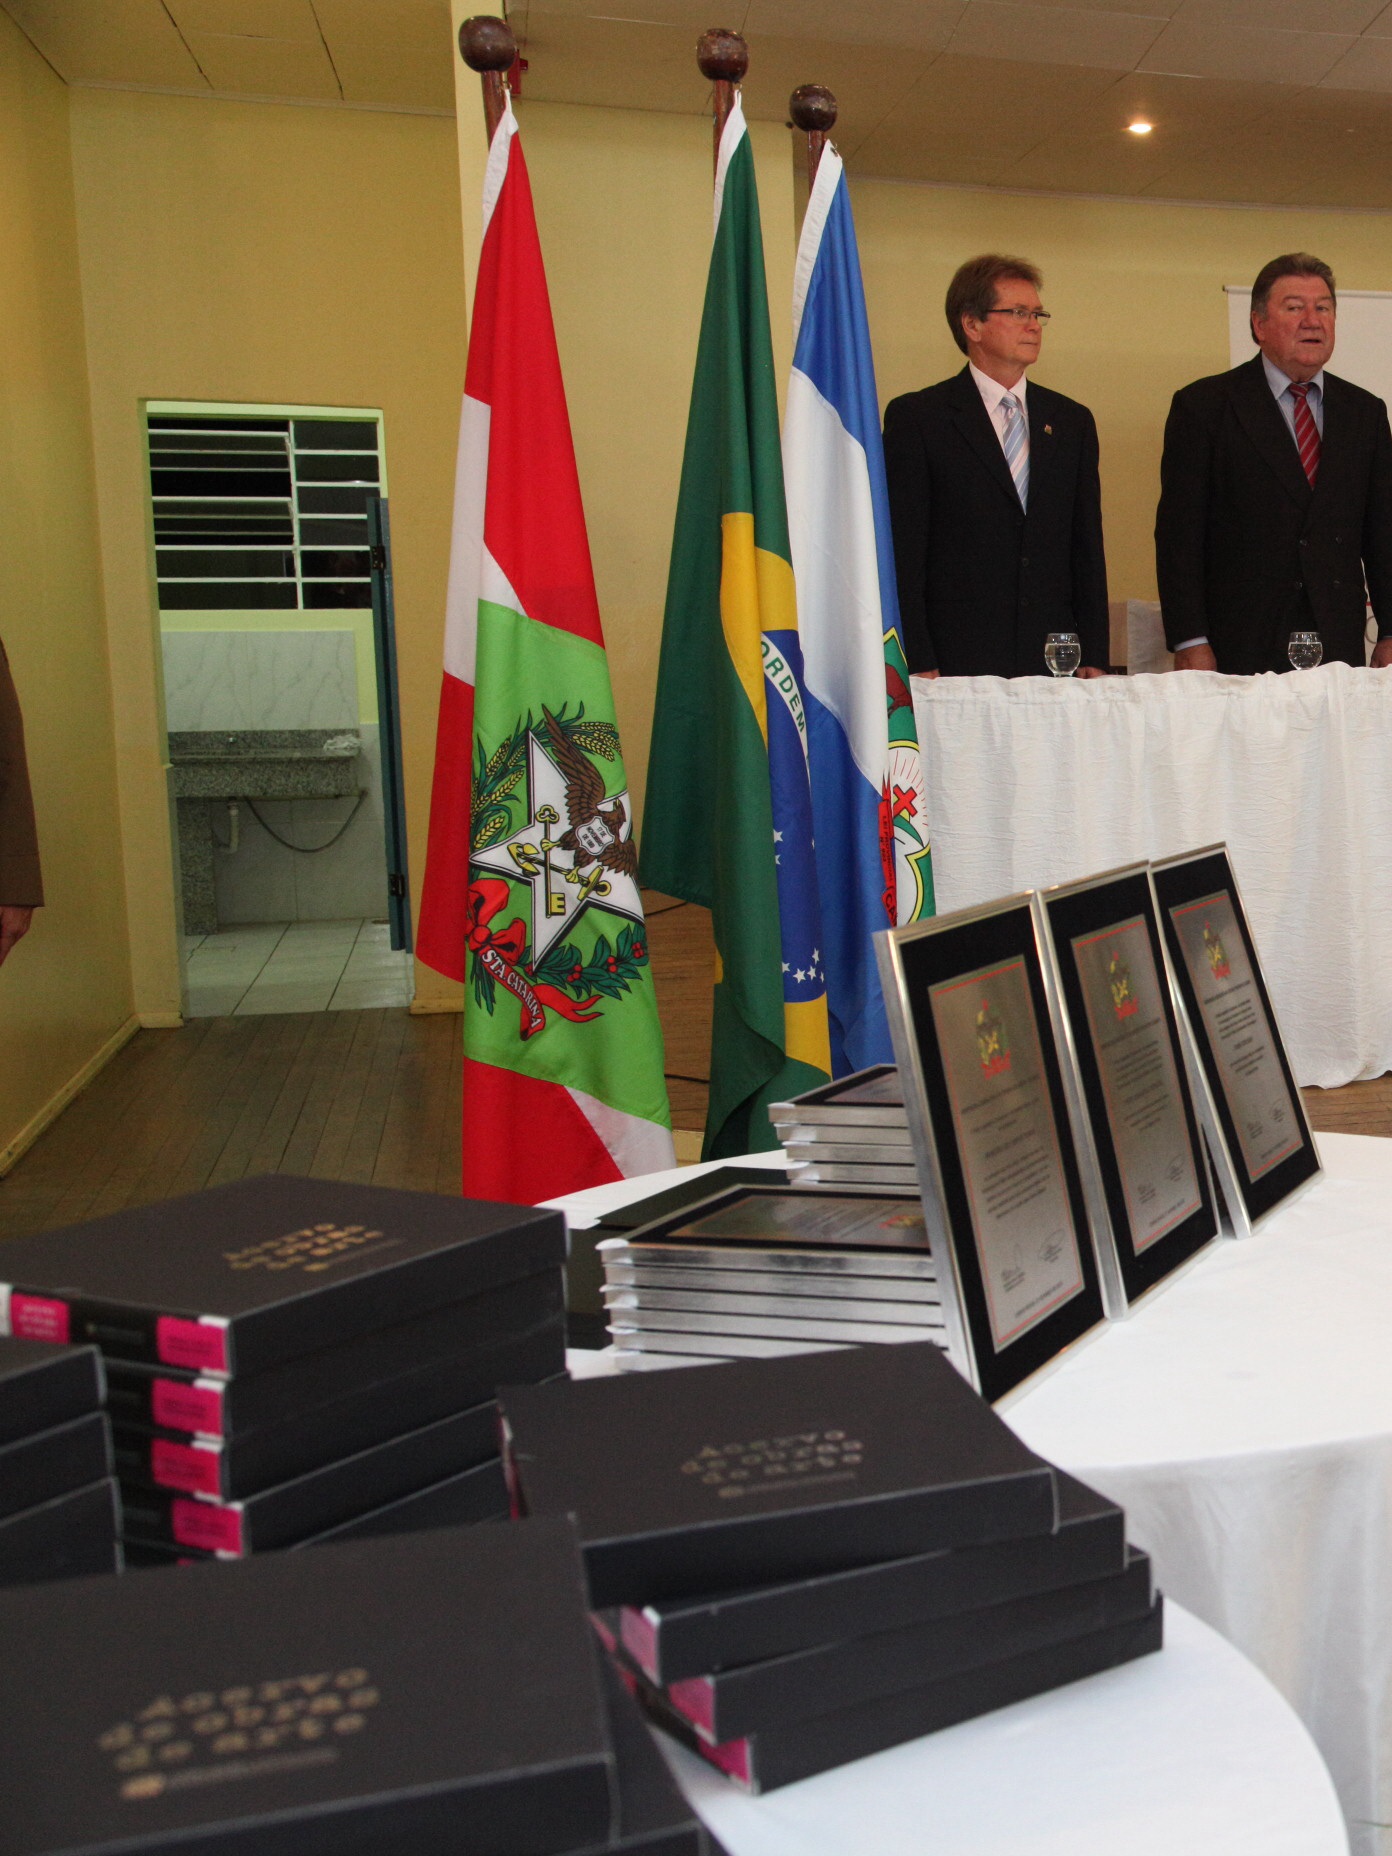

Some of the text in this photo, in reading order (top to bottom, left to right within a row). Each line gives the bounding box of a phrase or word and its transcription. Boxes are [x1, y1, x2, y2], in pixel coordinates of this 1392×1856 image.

[760, 640, 806, 733] ORDEM
[482, 949, 542, 1028] STA. CATARINA
